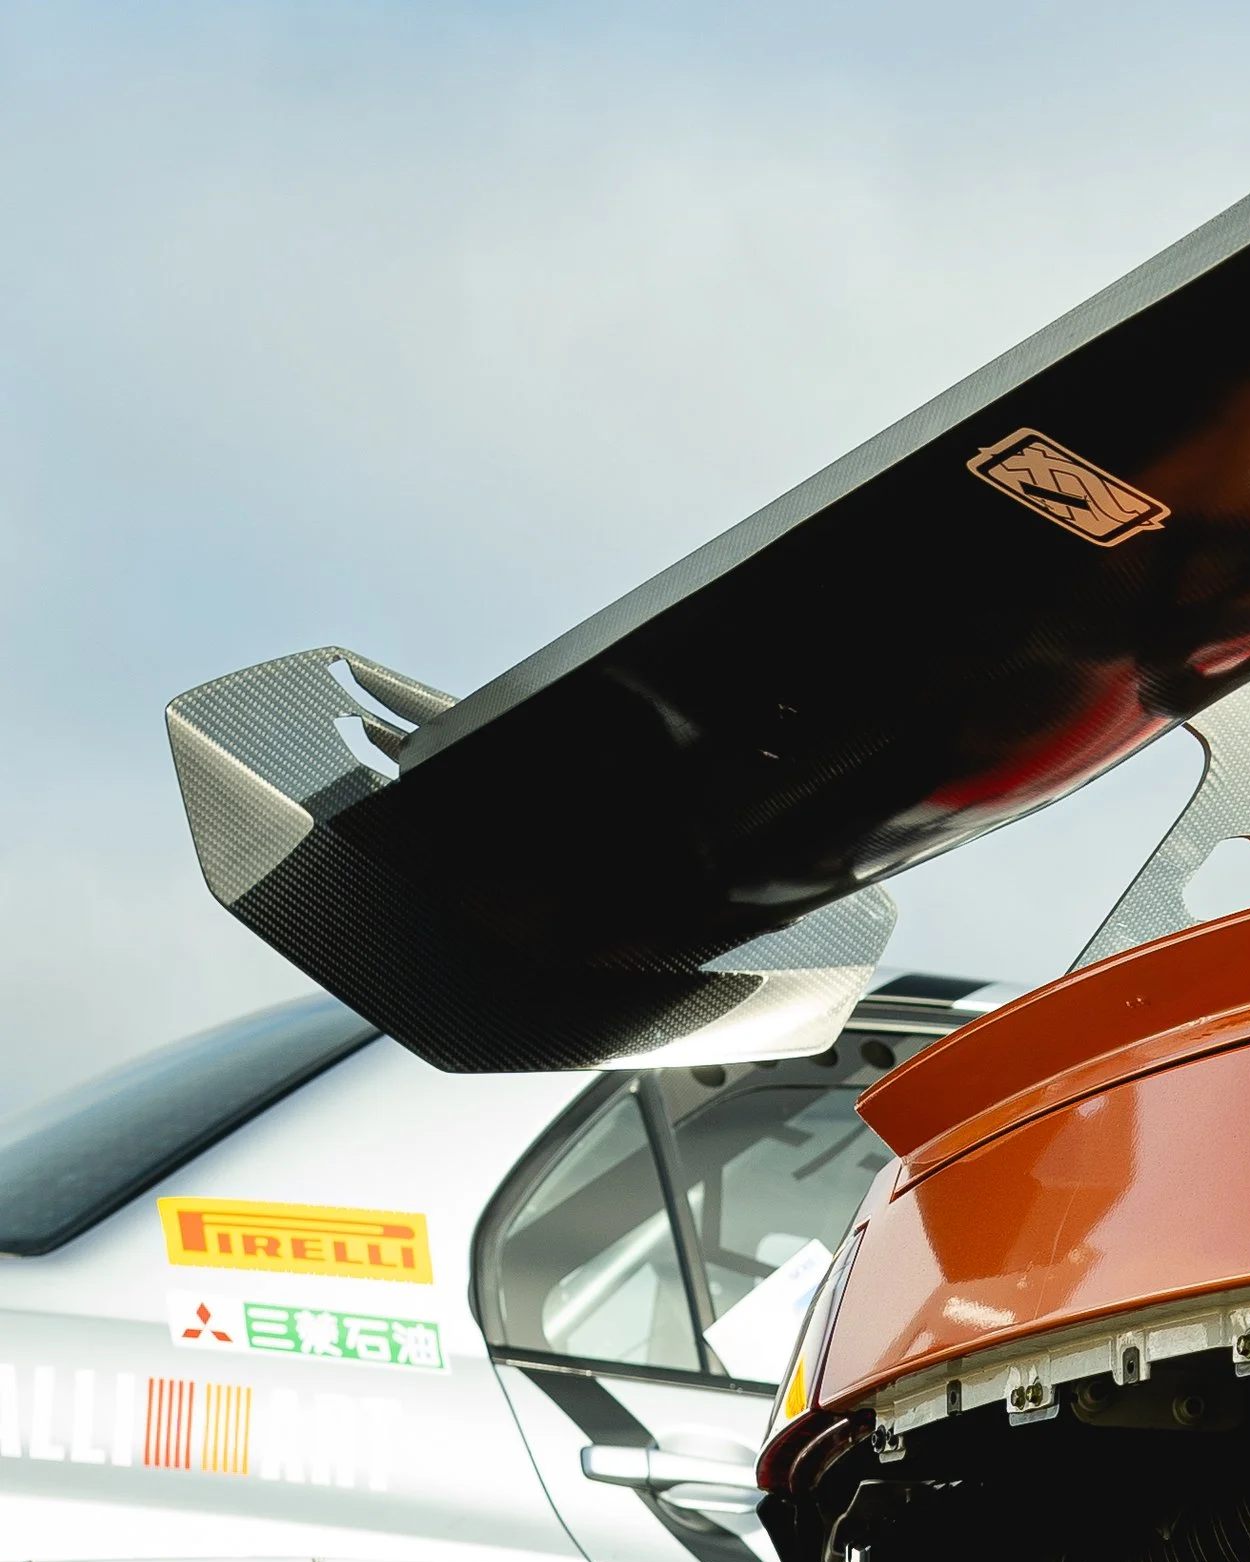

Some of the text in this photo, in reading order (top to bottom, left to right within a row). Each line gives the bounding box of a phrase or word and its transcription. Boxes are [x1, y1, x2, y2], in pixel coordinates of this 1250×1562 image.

[177, 1210, 416, 1270] PIRELLI
[246, 1306, 444, 1368] 三菱石油
